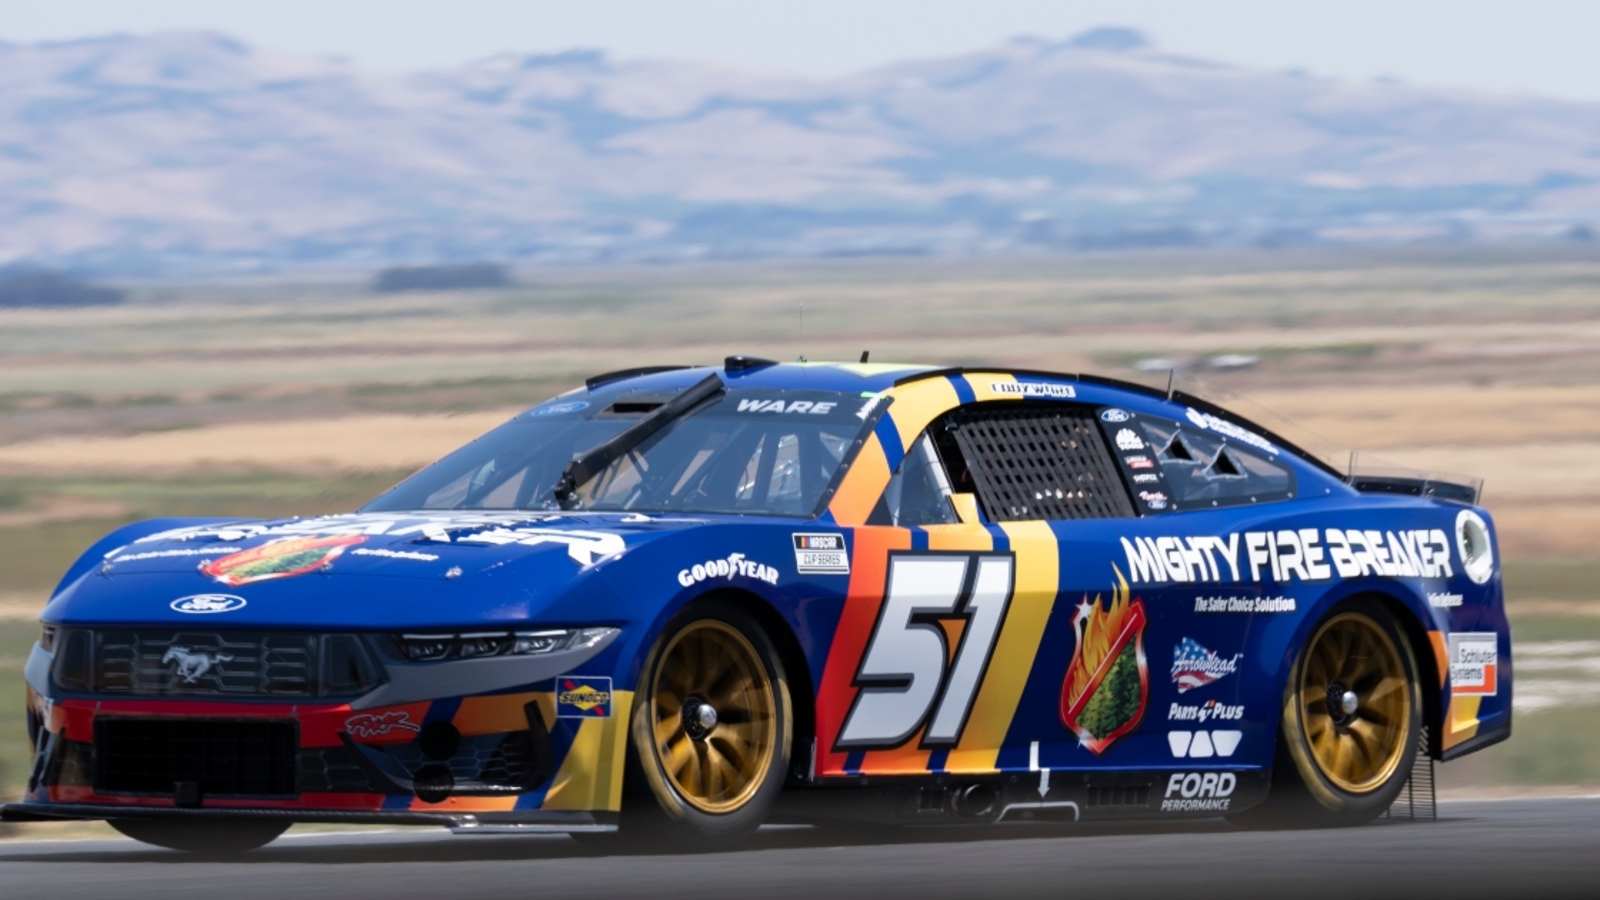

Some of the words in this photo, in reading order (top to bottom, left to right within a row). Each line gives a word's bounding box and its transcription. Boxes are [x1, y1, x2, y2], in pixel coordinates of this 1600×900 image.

[737, 399, 837, 415] WARE
[803, 553, 817, 565] CUP
[818, 553, 841, 566] SERIES
[1119, 531, 1241, 584] MIGHTY
[1244, 528, 1331, 583] FIRE
[1325, 528, 1454, 579] BREAKER
[1194, 596, 1207, 612] The
[1207, 596, 1228, 612] Safer
[1227, 596, 1254, 612] Choice
[1254, 596, 1296, 612] Solution
[830, 549, 1016, 753] 51
[560, 692, 608, 703] SUNOCO
[1168, 702, 1199, 720] PARTS
[1211, 702, 1245, 720] PLUS
[1164, 772, 1237, 798] FORD
[1161, 798, 1231, 811] PERFORMANCE
